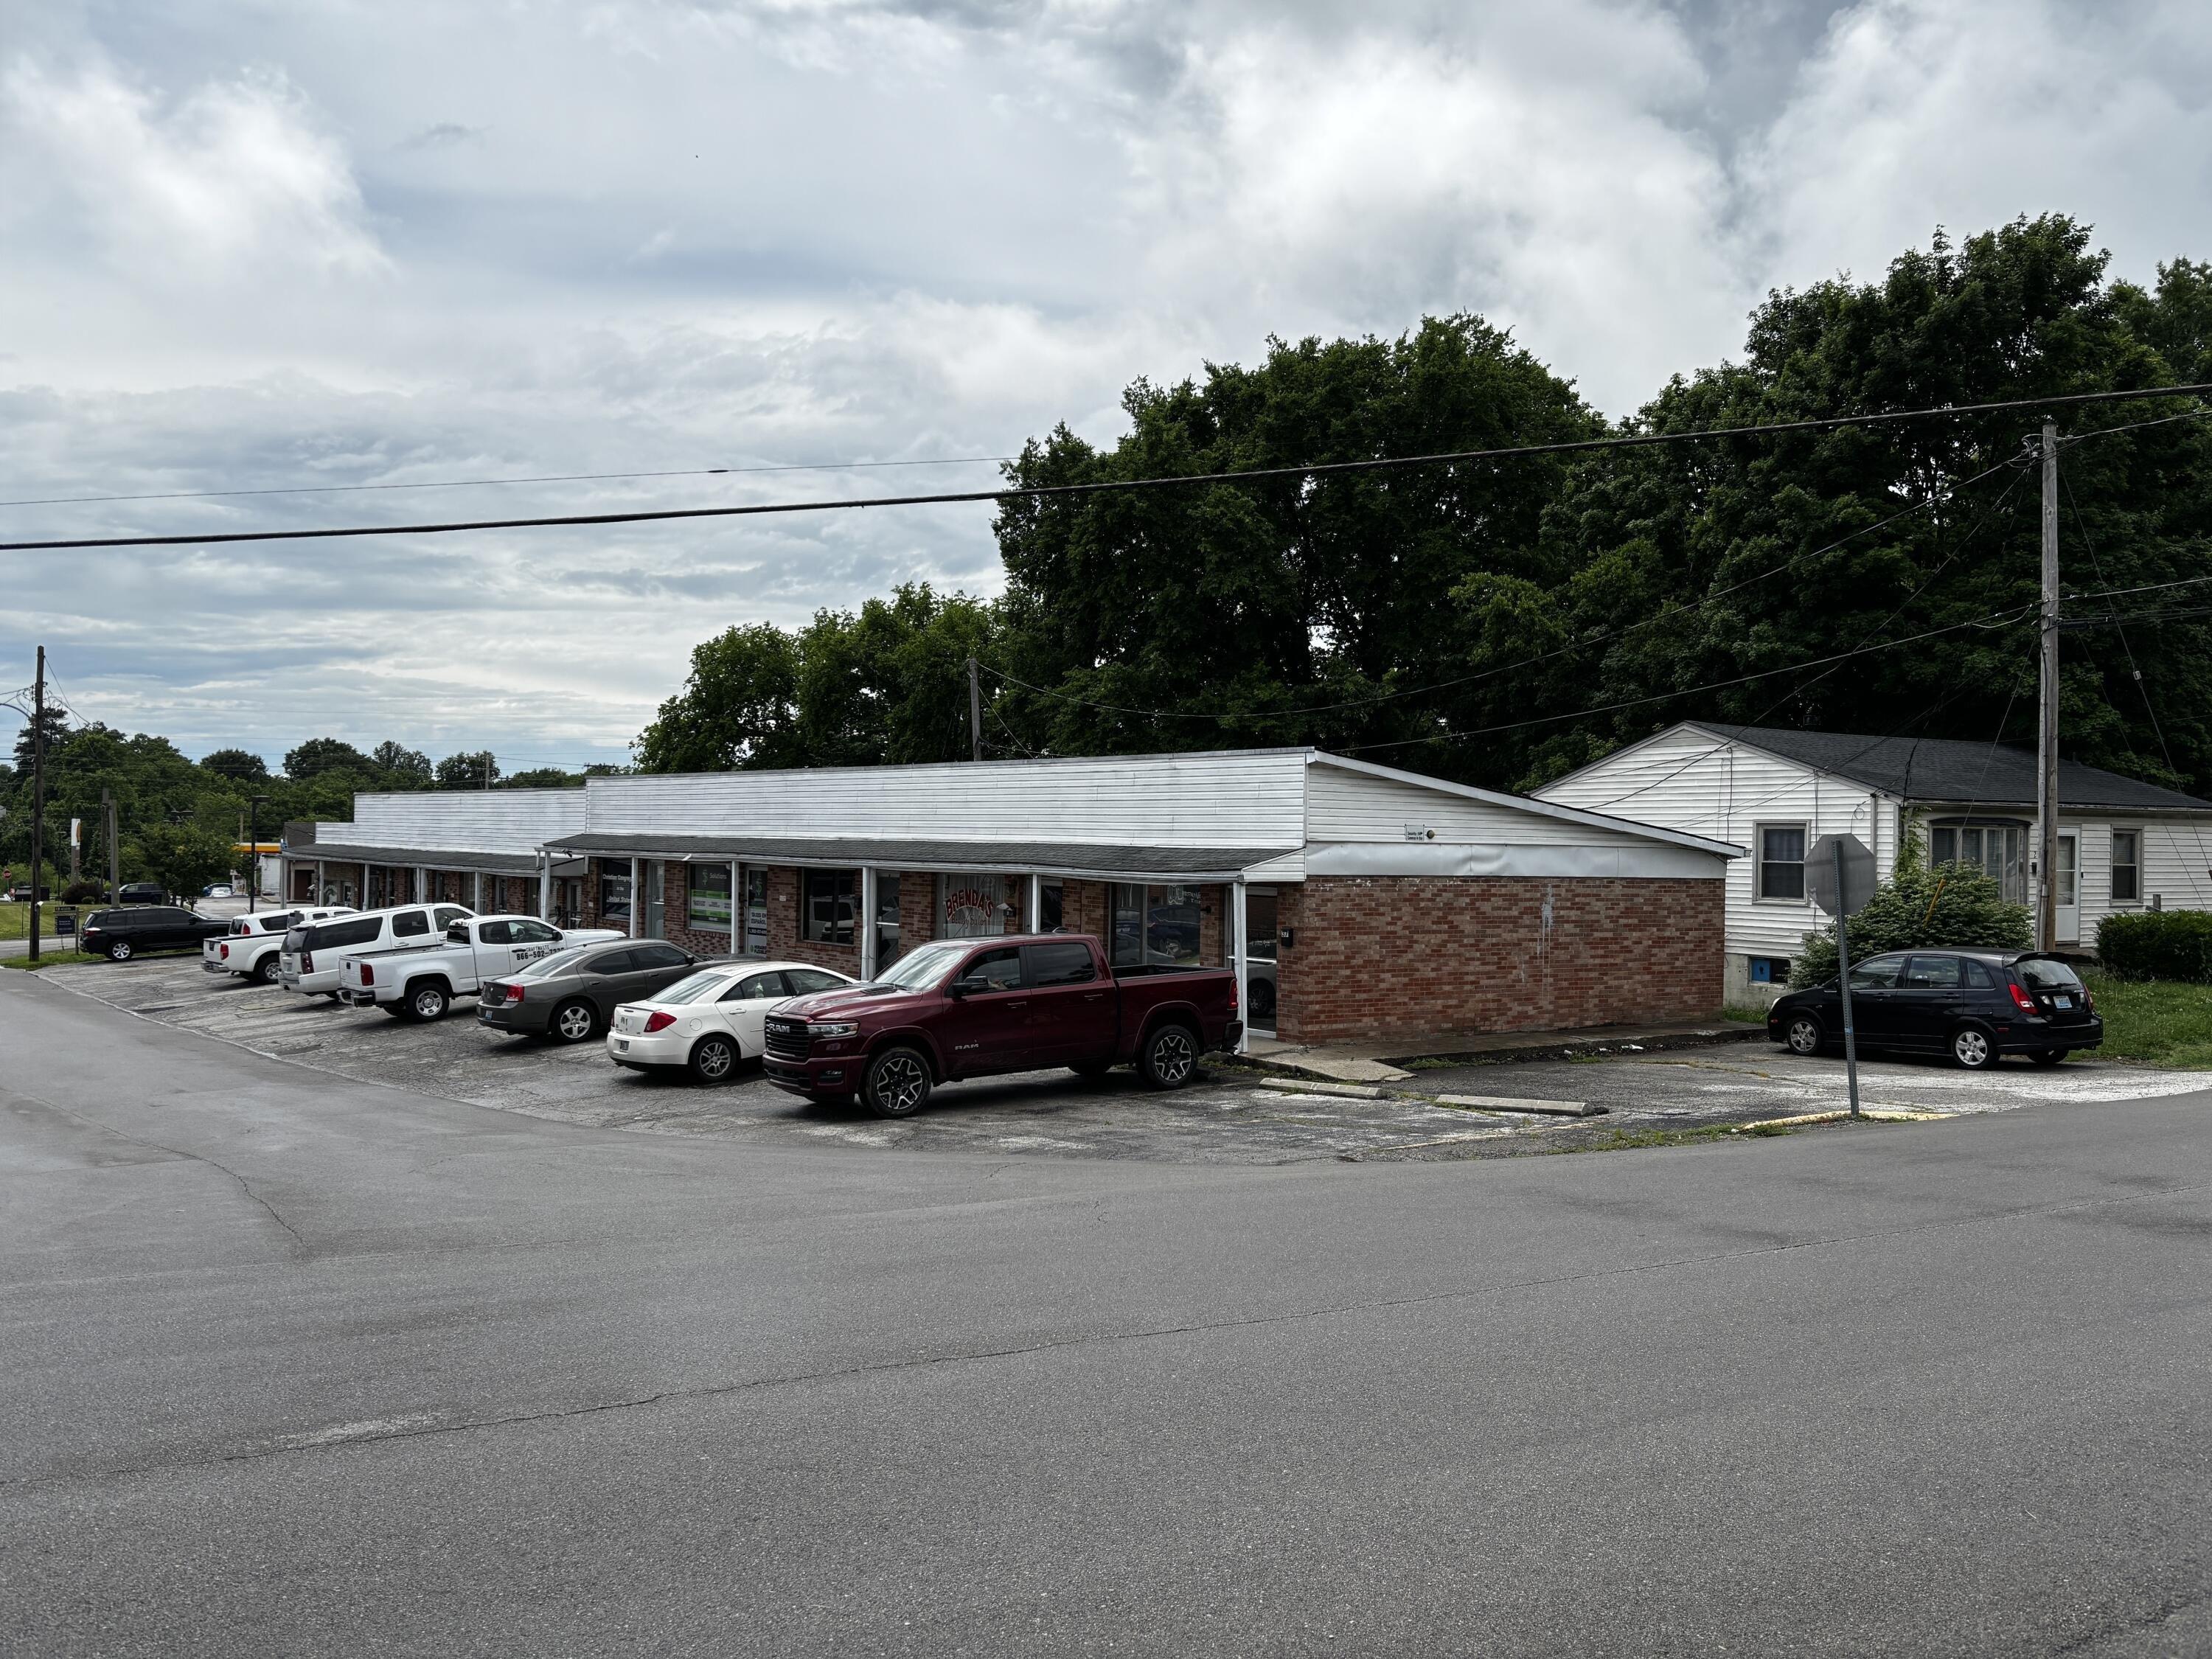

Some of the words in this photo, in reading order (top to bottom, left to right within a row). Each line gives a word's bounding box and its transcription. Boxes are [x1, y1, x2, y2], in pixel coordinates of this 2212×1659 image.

[944, 888, 994, 921] BRENDA'S
[951, 914, 969, 929] Beauty
[970, 915, 987, 926] Salon
[516, 947, 566, 960] 866-502-7
[768, 1023, 790, 1033] RAM
